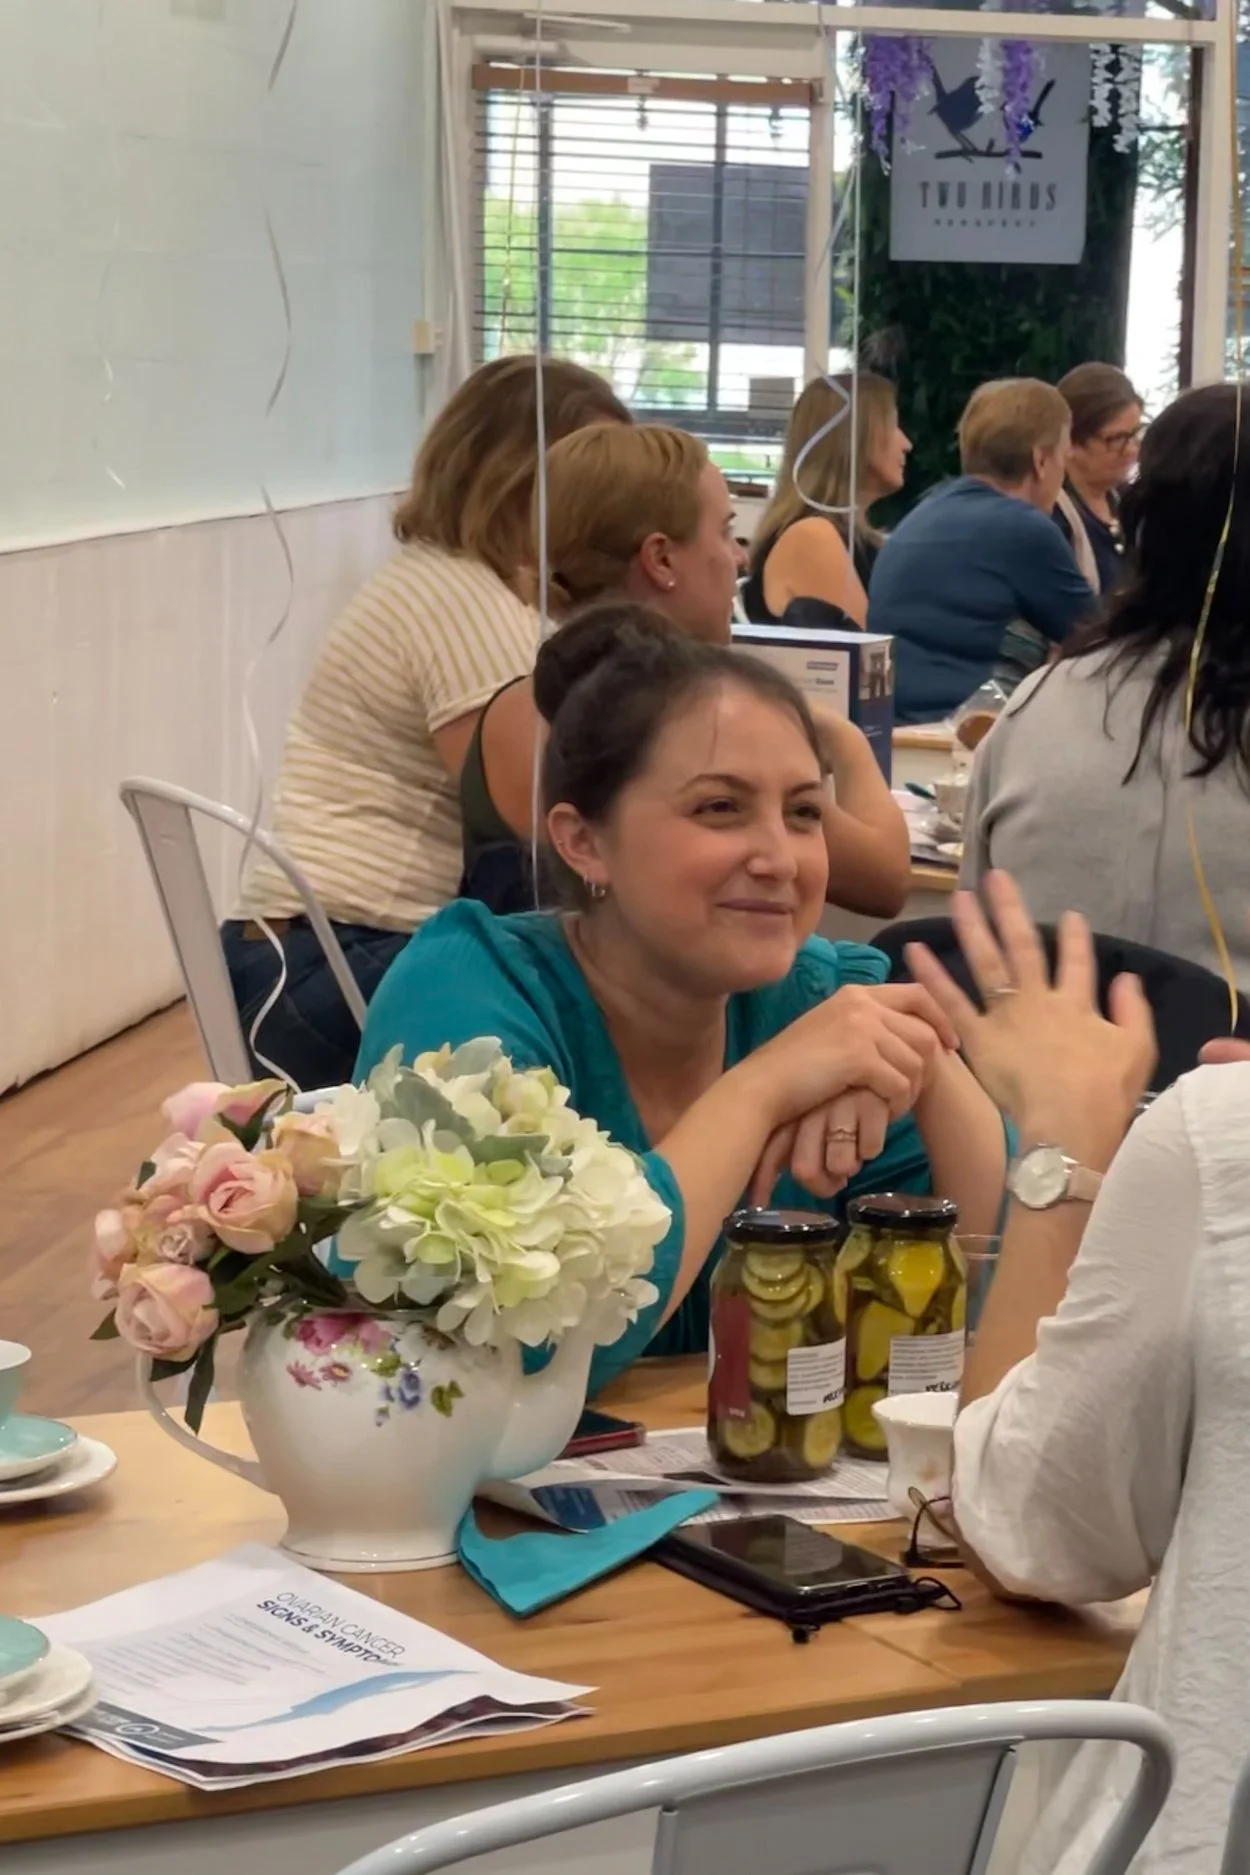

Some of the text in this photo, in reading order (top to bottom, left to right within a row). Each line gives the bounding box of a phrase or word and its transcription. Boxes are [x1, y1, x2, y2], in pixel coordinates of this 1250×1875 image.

[256, 1600, 402, 1666] SIGNS & SYMPTO
[276, 1592, 346, 1629] OVARIAN
[340, 1623, 406, 1659] CANCER
